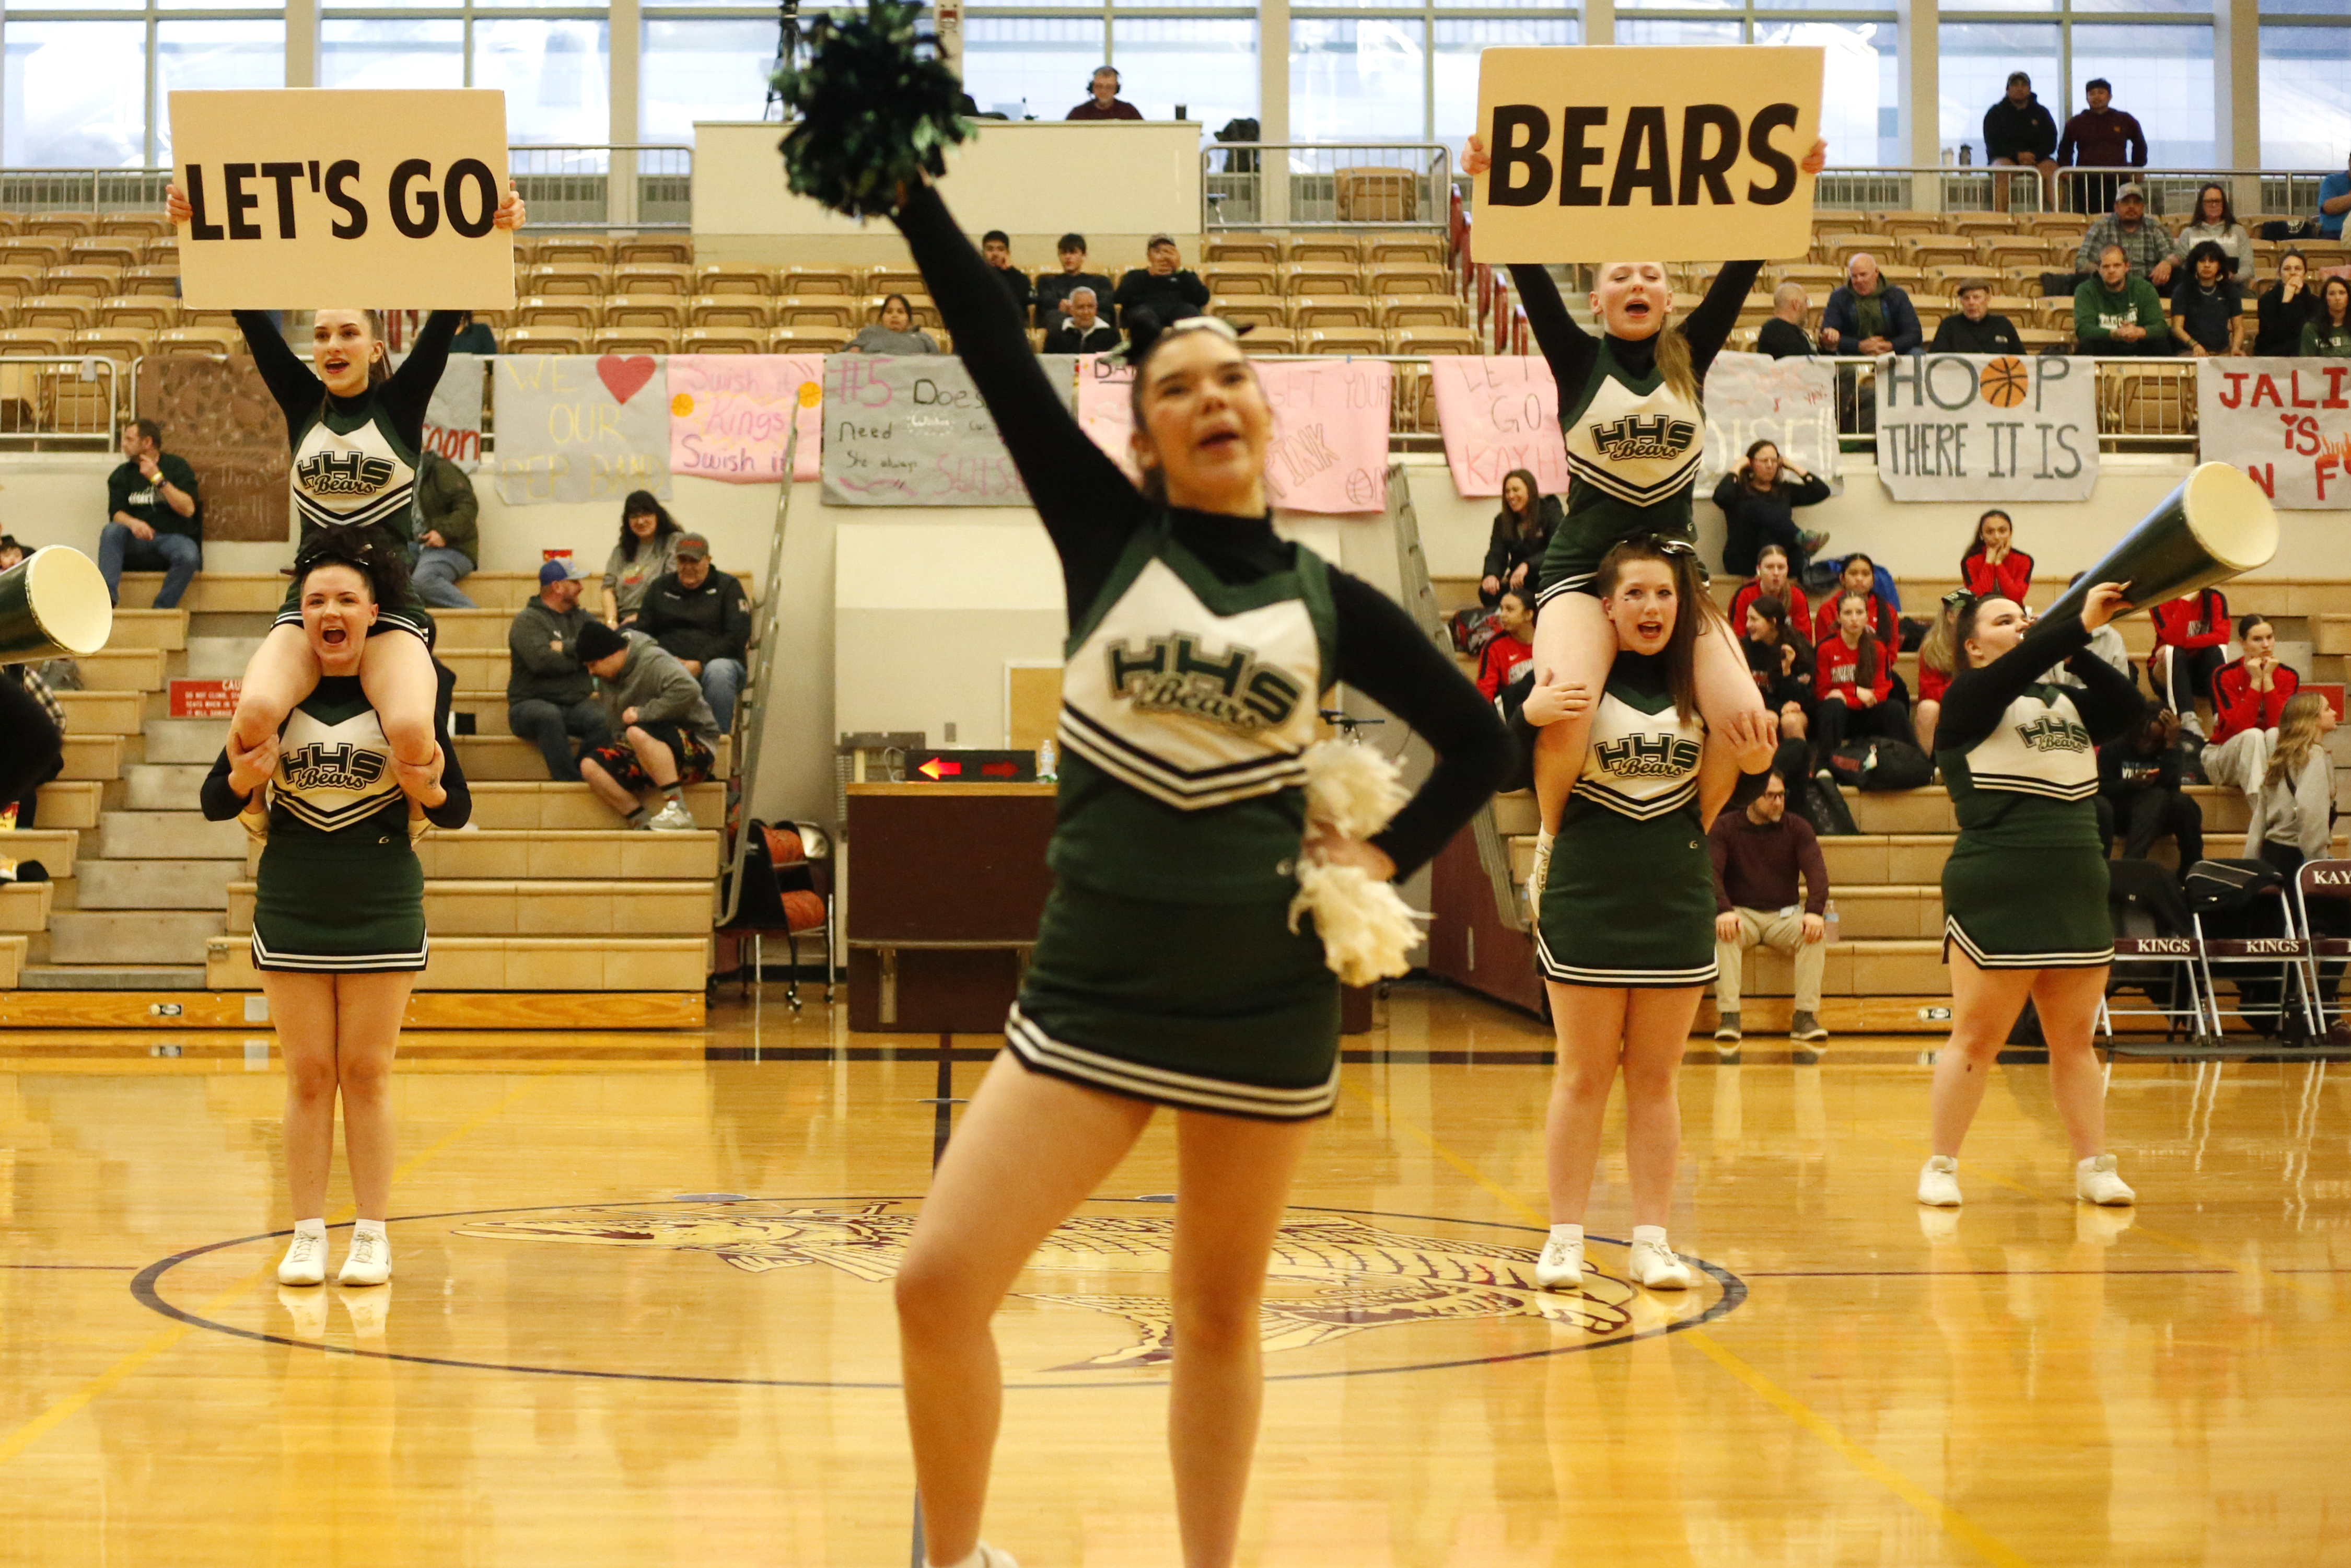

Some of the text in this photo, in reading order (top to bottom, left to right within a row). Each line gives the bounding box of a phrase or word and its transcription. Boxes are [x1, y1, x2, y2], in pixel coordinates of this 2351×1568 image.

[1488, 103, 1799, 207] BEARS
[185, 158, 498, 240] LET'S GO
[505, 356, 578, 392] WE
[824, 358, 894, 408] #5
[2219, 367, 2349, 409] JALI
[549, 402, 625, 445] OUR
[703, 397, 785, 442] Kings
[1492, 393, 1541, 433] GO
[681, 433, 754, 472] Swish
[1590, 414, 1696, 454] HHS
[1611, 440, 1678, 460] Bears
[1882, 422, 2082, 480] THERE IT IS
[297, 451, 395, 490] HHS
[313, 473, 376, 495] Bears
[1104, 630, 1305, 727] HHS
[2016, 716, 2090, 749] HHS
[2039, 733, 2084, 753] Bears
[280, 742, 387, 784] HHS
[1595, 733, 1702, 772] HHS
[1614, 757, 1685, 777] Bears
[296, 768, 367, 790] Bears
[2138, 939, 2191, 953] KINGS
[2247, 940, 2299, 953] KINGS
